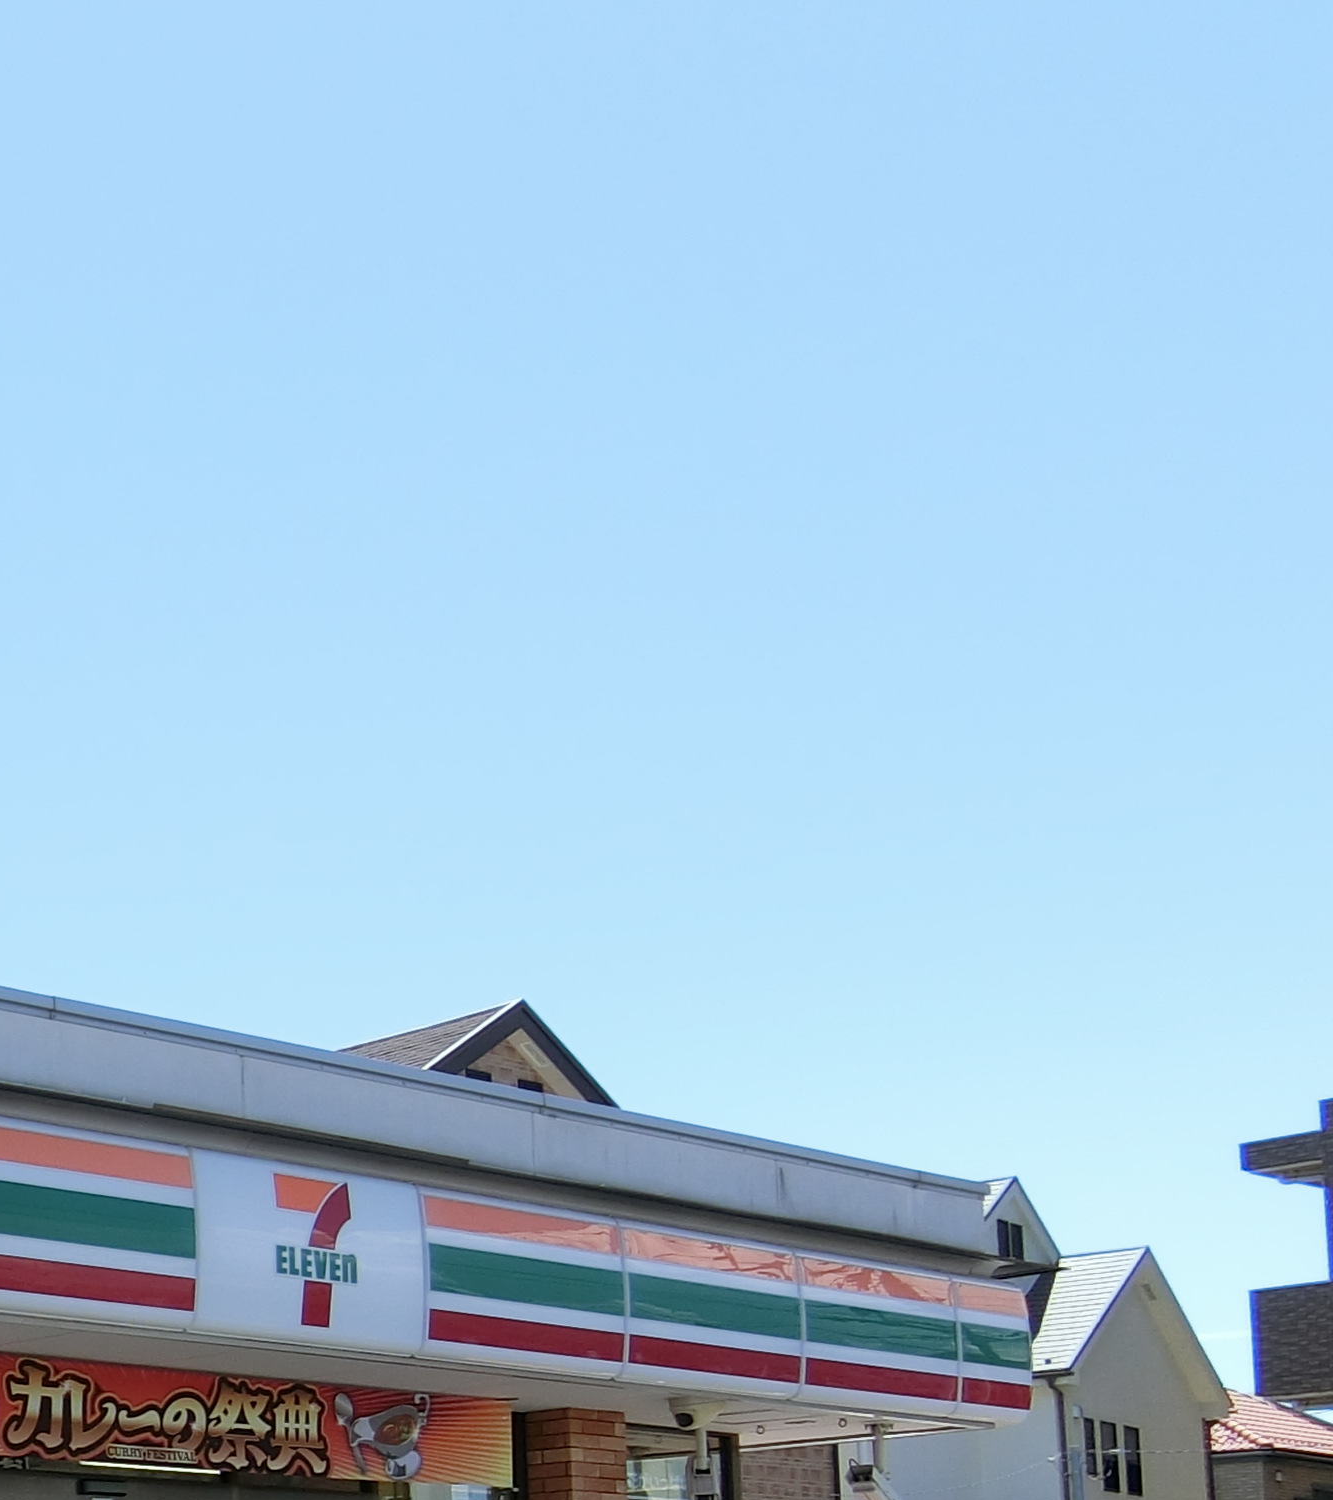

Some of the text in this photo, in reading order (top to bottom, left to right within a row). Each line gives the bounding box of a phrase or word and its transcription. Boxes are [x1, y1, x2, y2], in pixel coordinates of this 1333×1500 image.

[6, 1360, 329, 1475] カレーの祭典
[107, 1446, 198, 1463] CURRY FESTIVAL
